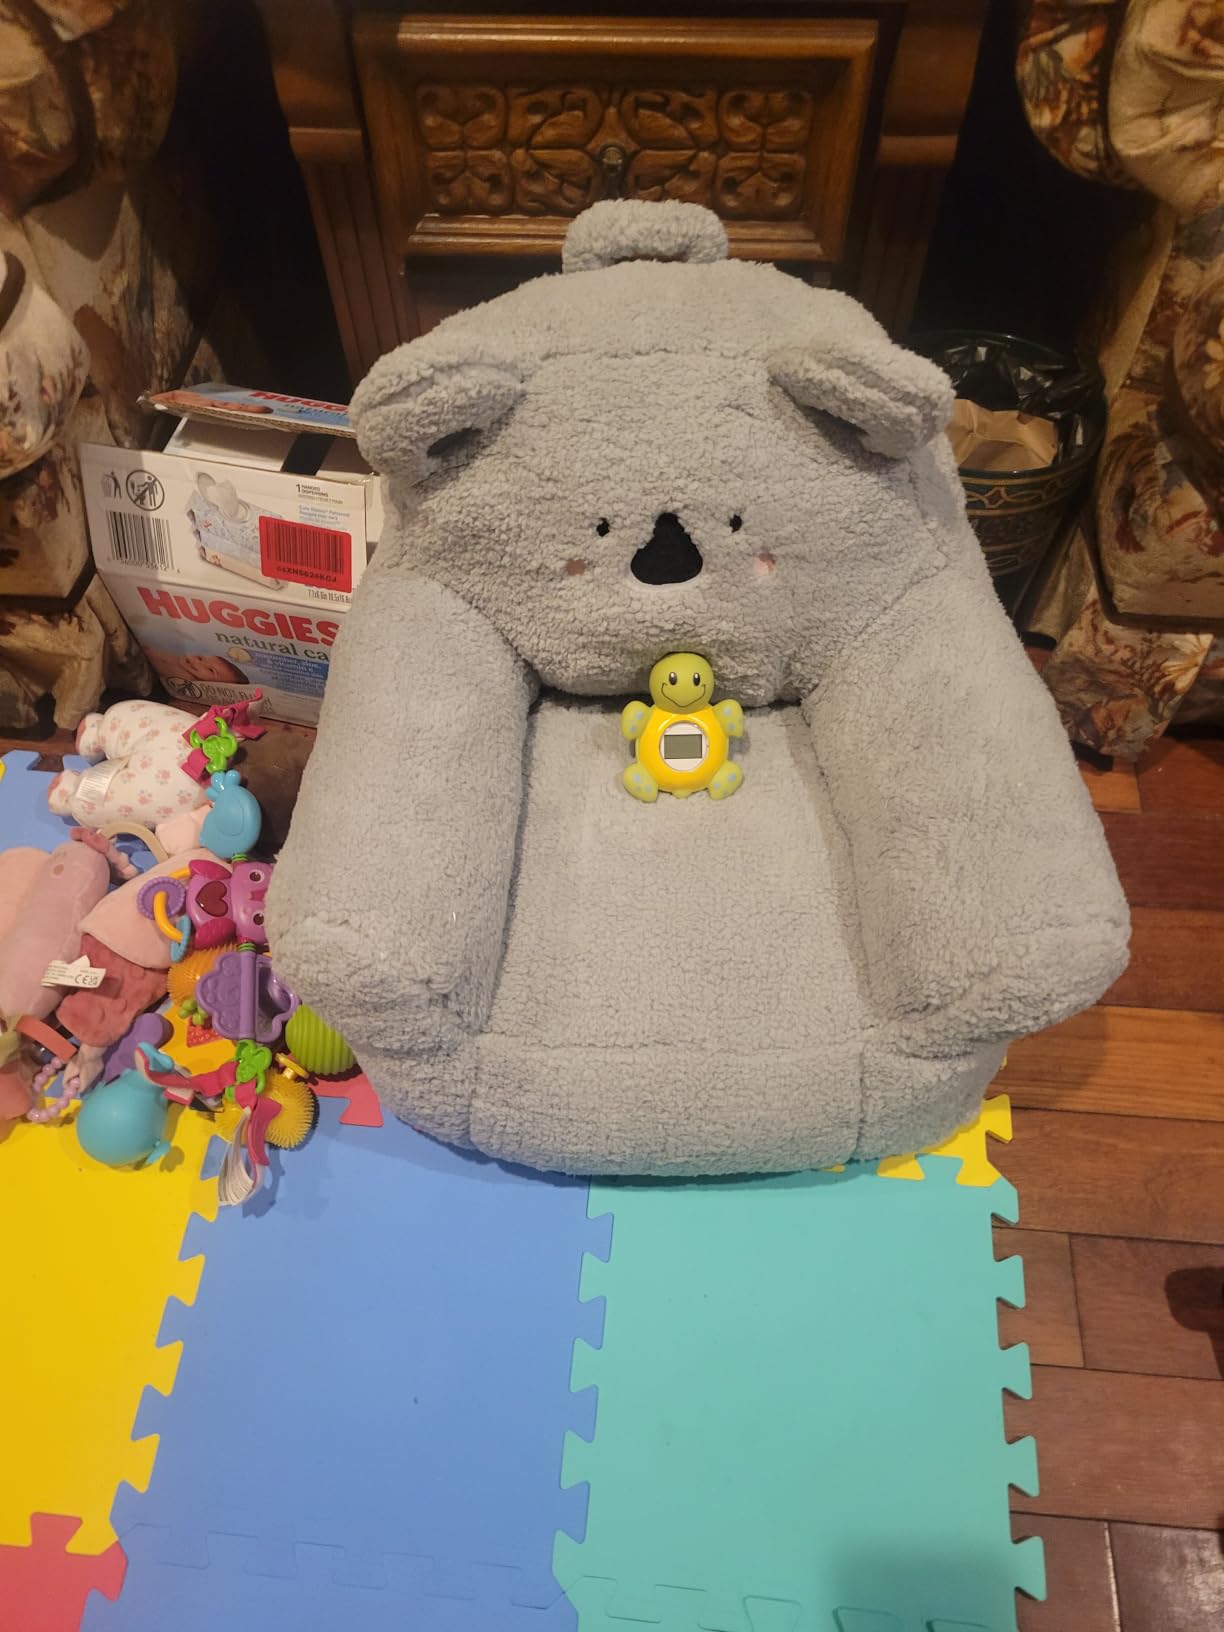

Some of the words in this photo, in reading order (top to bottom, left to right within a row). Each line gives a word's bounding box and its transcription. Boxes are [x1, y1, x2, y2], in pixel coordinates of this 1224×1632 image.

[137, 586, 339, 647] HUGGIES
[216, 631, 299, 656] natural
[304, 649, 329, 661] ca
